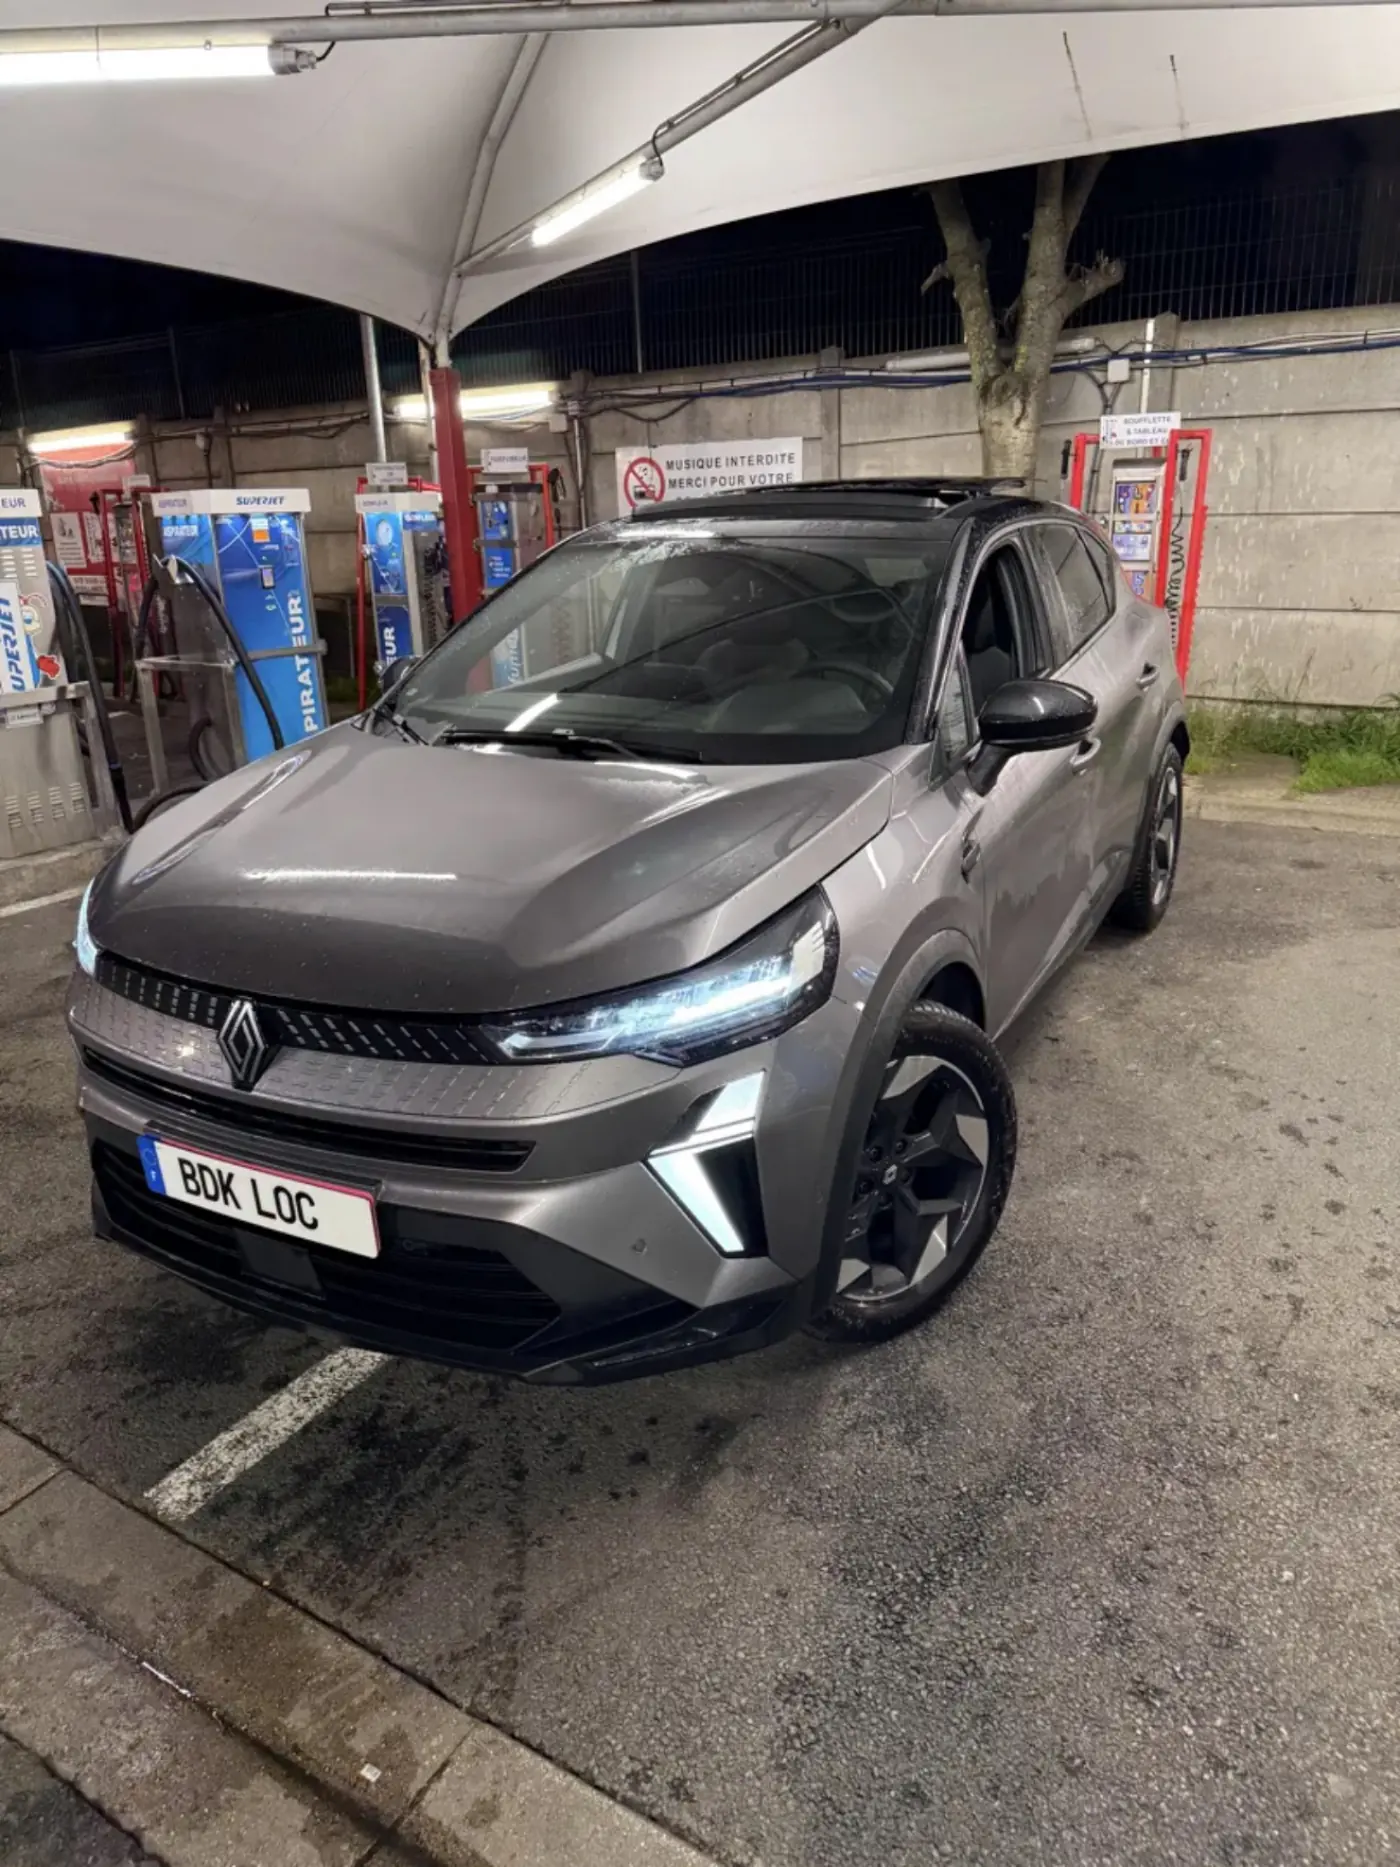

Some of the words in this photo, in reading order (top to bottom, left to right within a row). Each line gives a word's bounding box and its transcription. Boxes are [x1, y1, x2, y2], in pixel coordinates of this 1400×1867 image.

[666, 458, 722, 470] MUSIQUE
[725, 453, 796, 468] INTERDITE
[668, 477, 707, 489] MERCI
[710, 475, 745, 487] POUR
[749, 472, 794, 485] VOTRE
[236, 495, 285, 505] SUPERJET
[0, 525, 39, 539] TEUR
[178, 1157, 242, 1210] BDK
[251, 1178, 319, 1231] LOC
